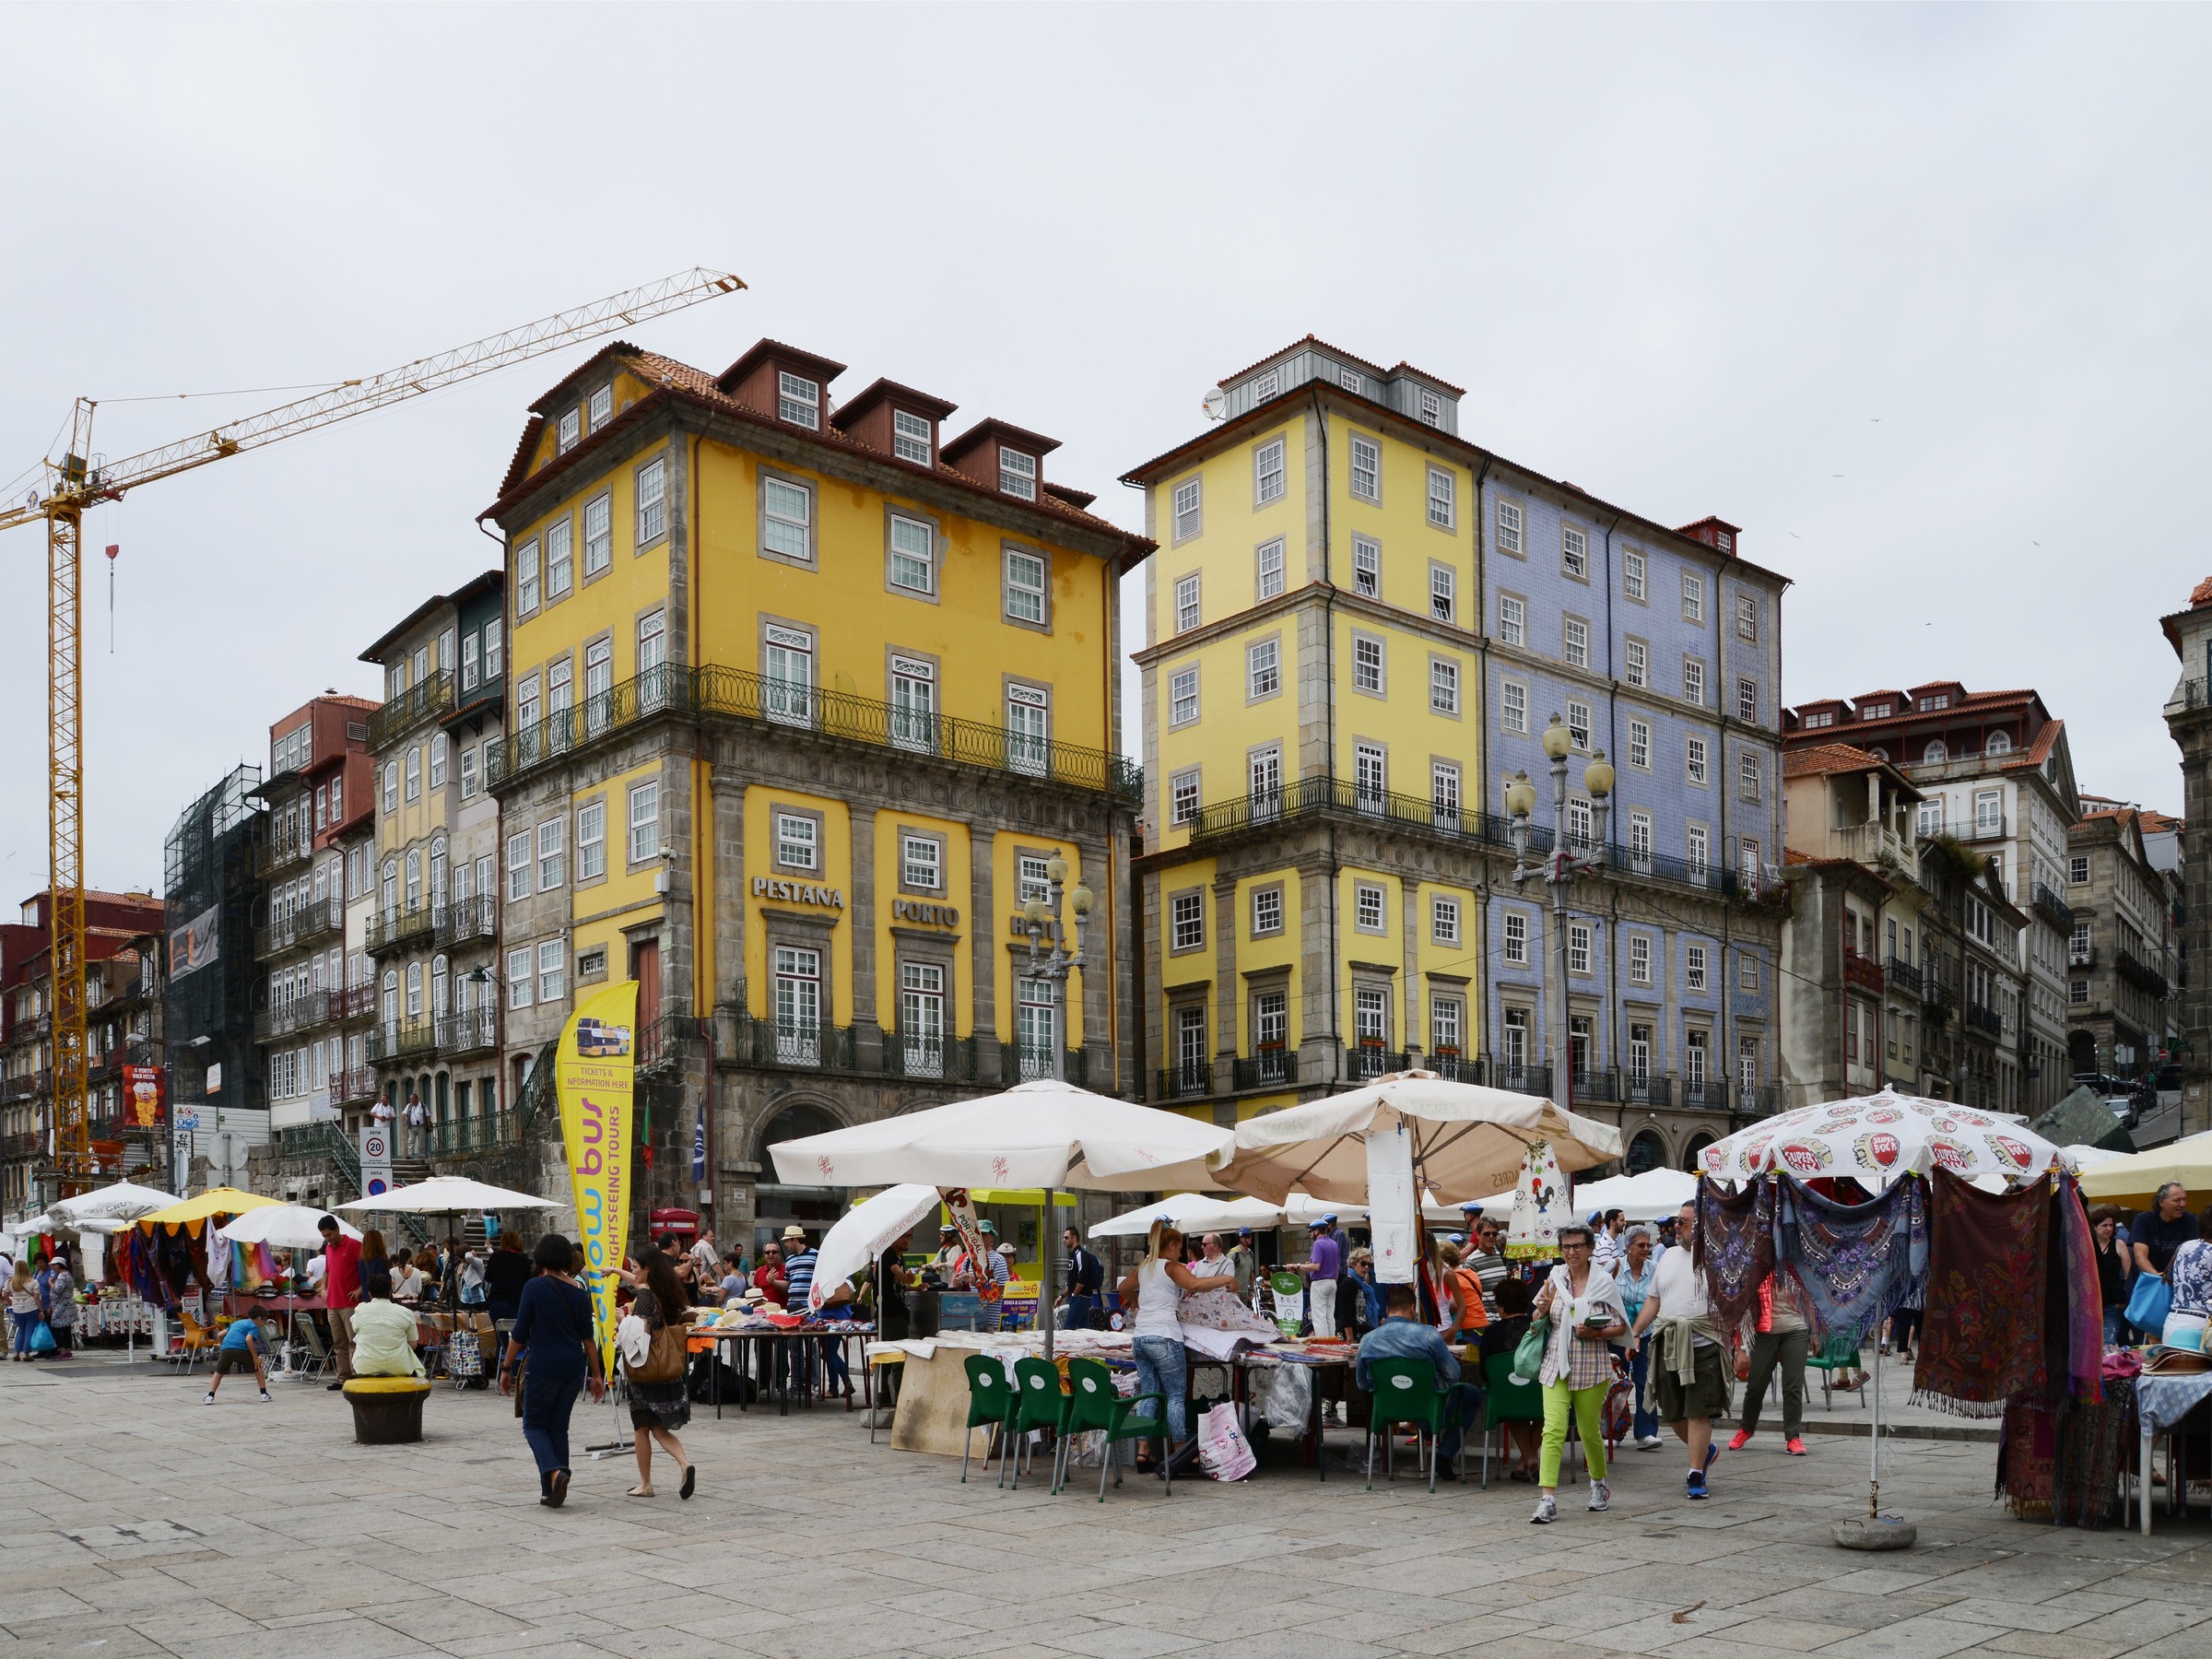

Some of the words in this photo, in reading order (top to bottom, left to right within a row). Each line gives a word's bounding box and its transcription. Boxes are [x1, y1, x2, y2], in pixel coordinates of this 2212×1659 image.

[752, 876, 845, 909] PESTANA
[893, 899, 959, 927] PORTO
[581, 1067, 606, 1077] TICKETS
[1411, 1101, 1459, 1116] SAGRES
[576, 1098, 603, 1176] bus
[607, 1105, 620, 1158] TOURS
[1262, 1118, 1306, 1138] SAGRES
[370, 1143, 382, 1151] 20
[1784, 1151, 1814, 1164] SUPER
[1873, 1142, 1898, 1154] BOCK
[105, 1201, 135, 1213] CRUZ
[607, 1165, 620, 1266] IGHTSEEING
[873, 1205, 926, 1251] intensamente
[957, 1214, 982, 1254] PORTUGAL
[584, 1187, 607, 1344] ellow
